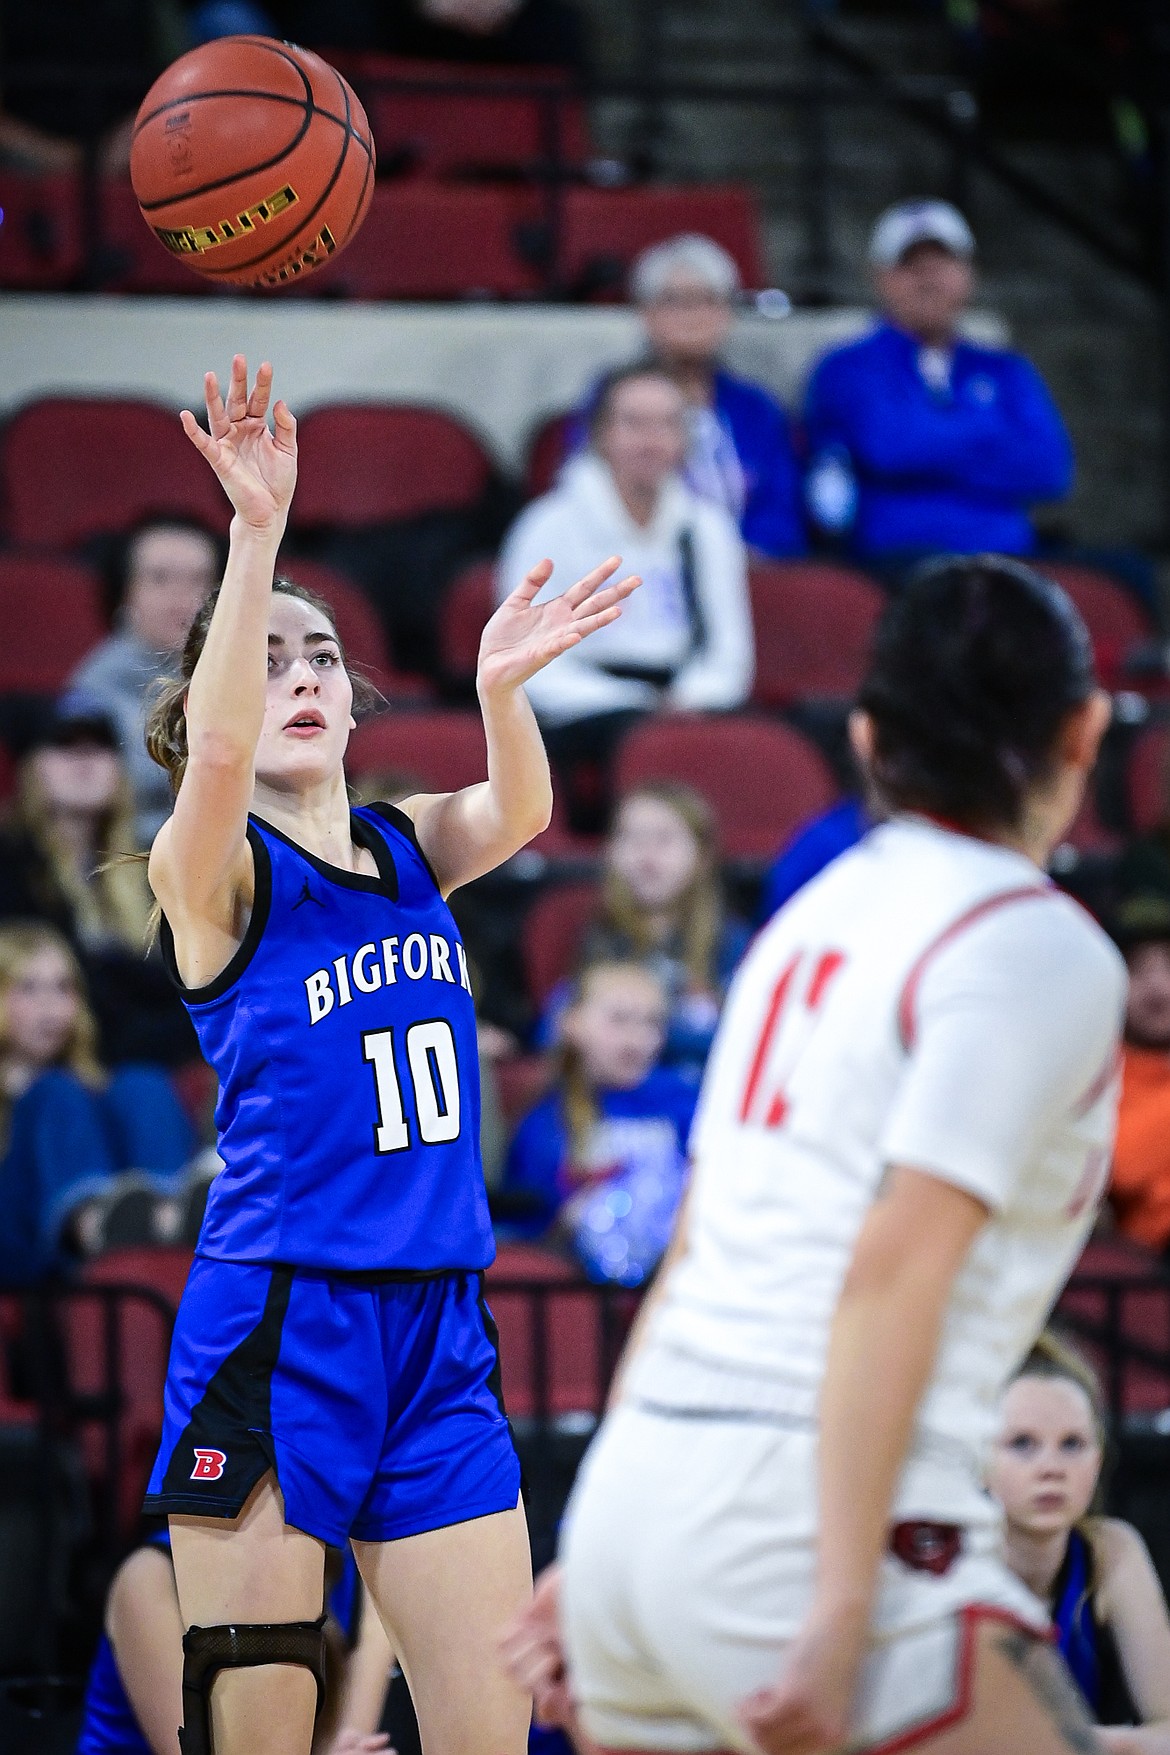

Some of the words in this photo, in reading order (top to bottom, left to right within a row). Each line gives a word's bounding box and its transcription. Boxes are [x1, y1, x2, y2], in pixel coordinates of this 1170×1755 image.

[195, 183, 300, 252] ELITE
[360, 1017, 461, 1156] 10
[190, 1448, 227, 1481] B
